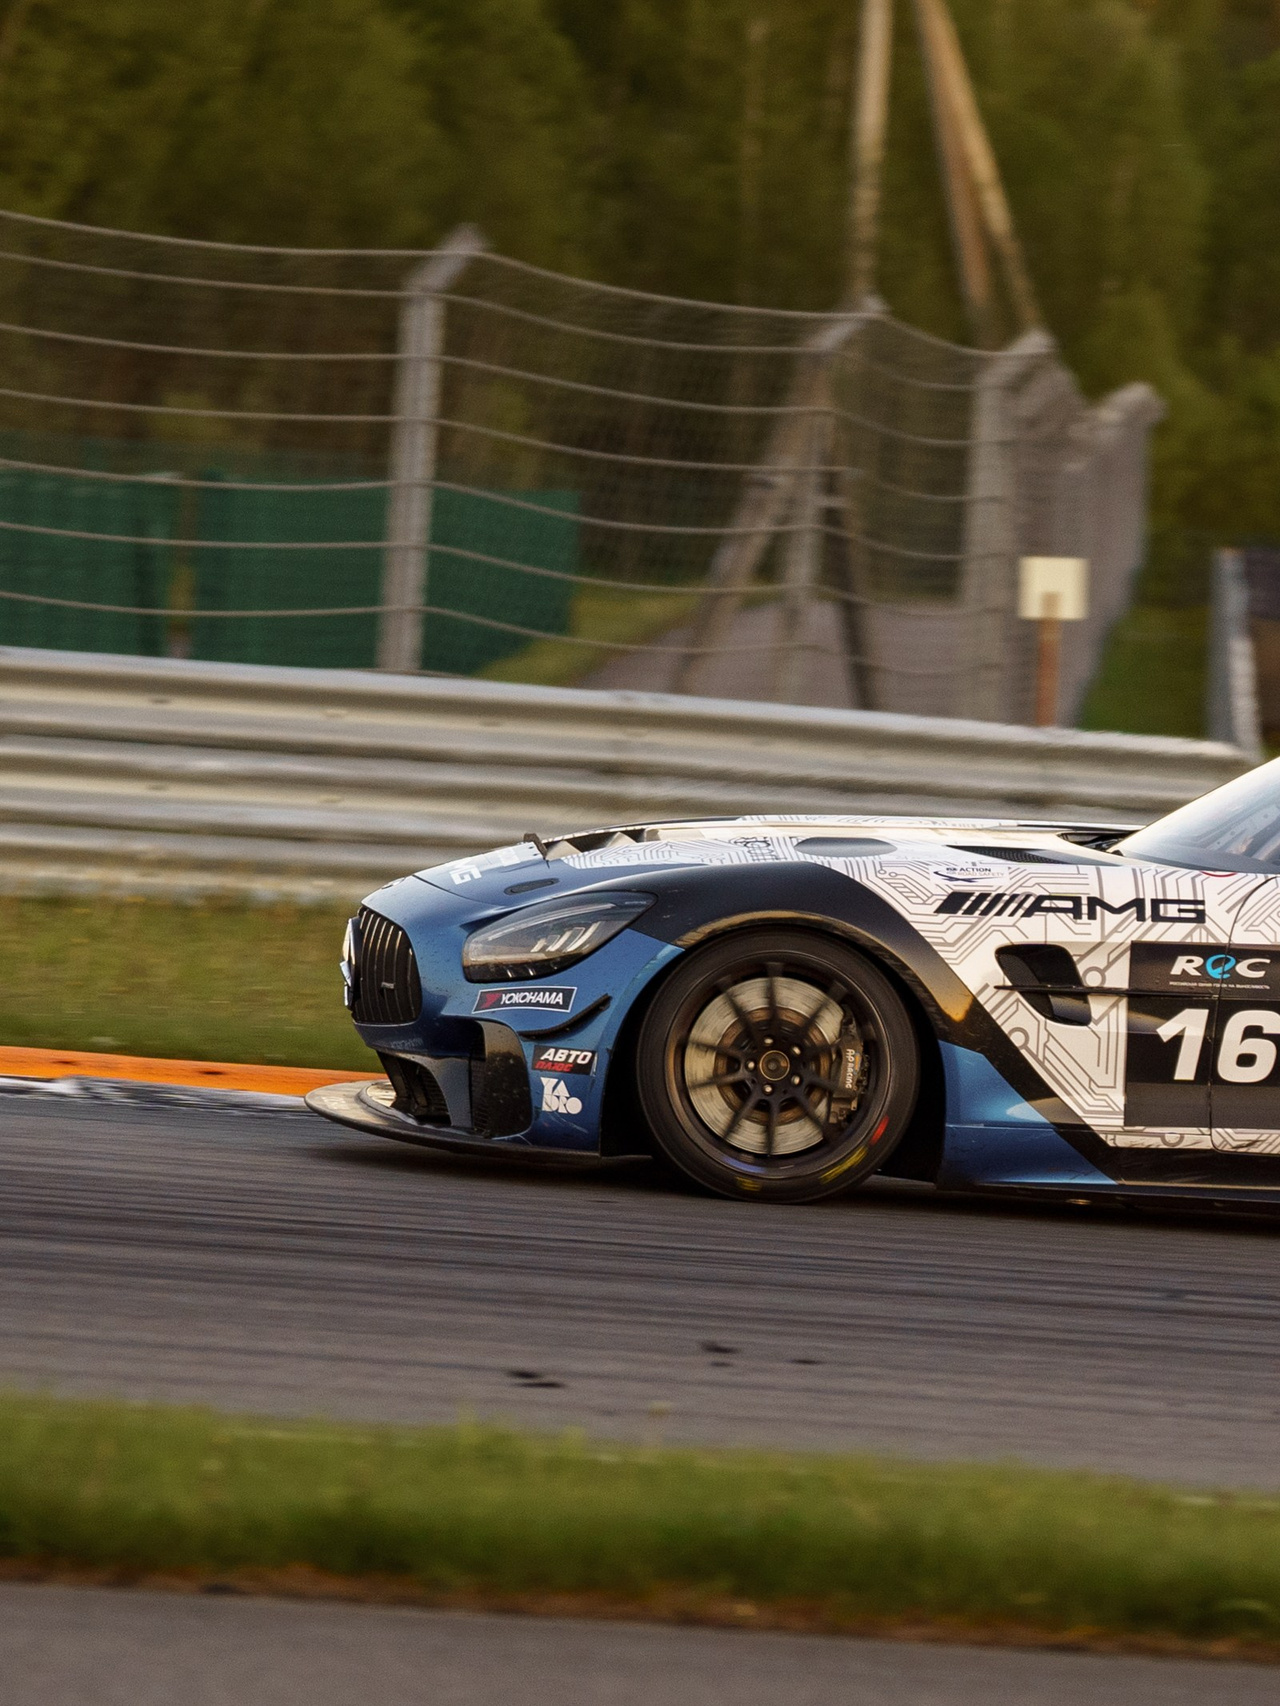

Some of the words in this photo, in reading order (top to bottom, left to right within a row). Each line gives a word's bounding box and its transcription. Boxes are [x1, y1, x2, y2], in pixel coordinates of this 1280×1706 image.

[1019, 893, 1206, 924] AMG
[500, 991, 564, 1006] YOKOHAMA
[540, 1048, 592, 1065] АВТО
[534, 1060, 574, 1073] ПЛЮС
